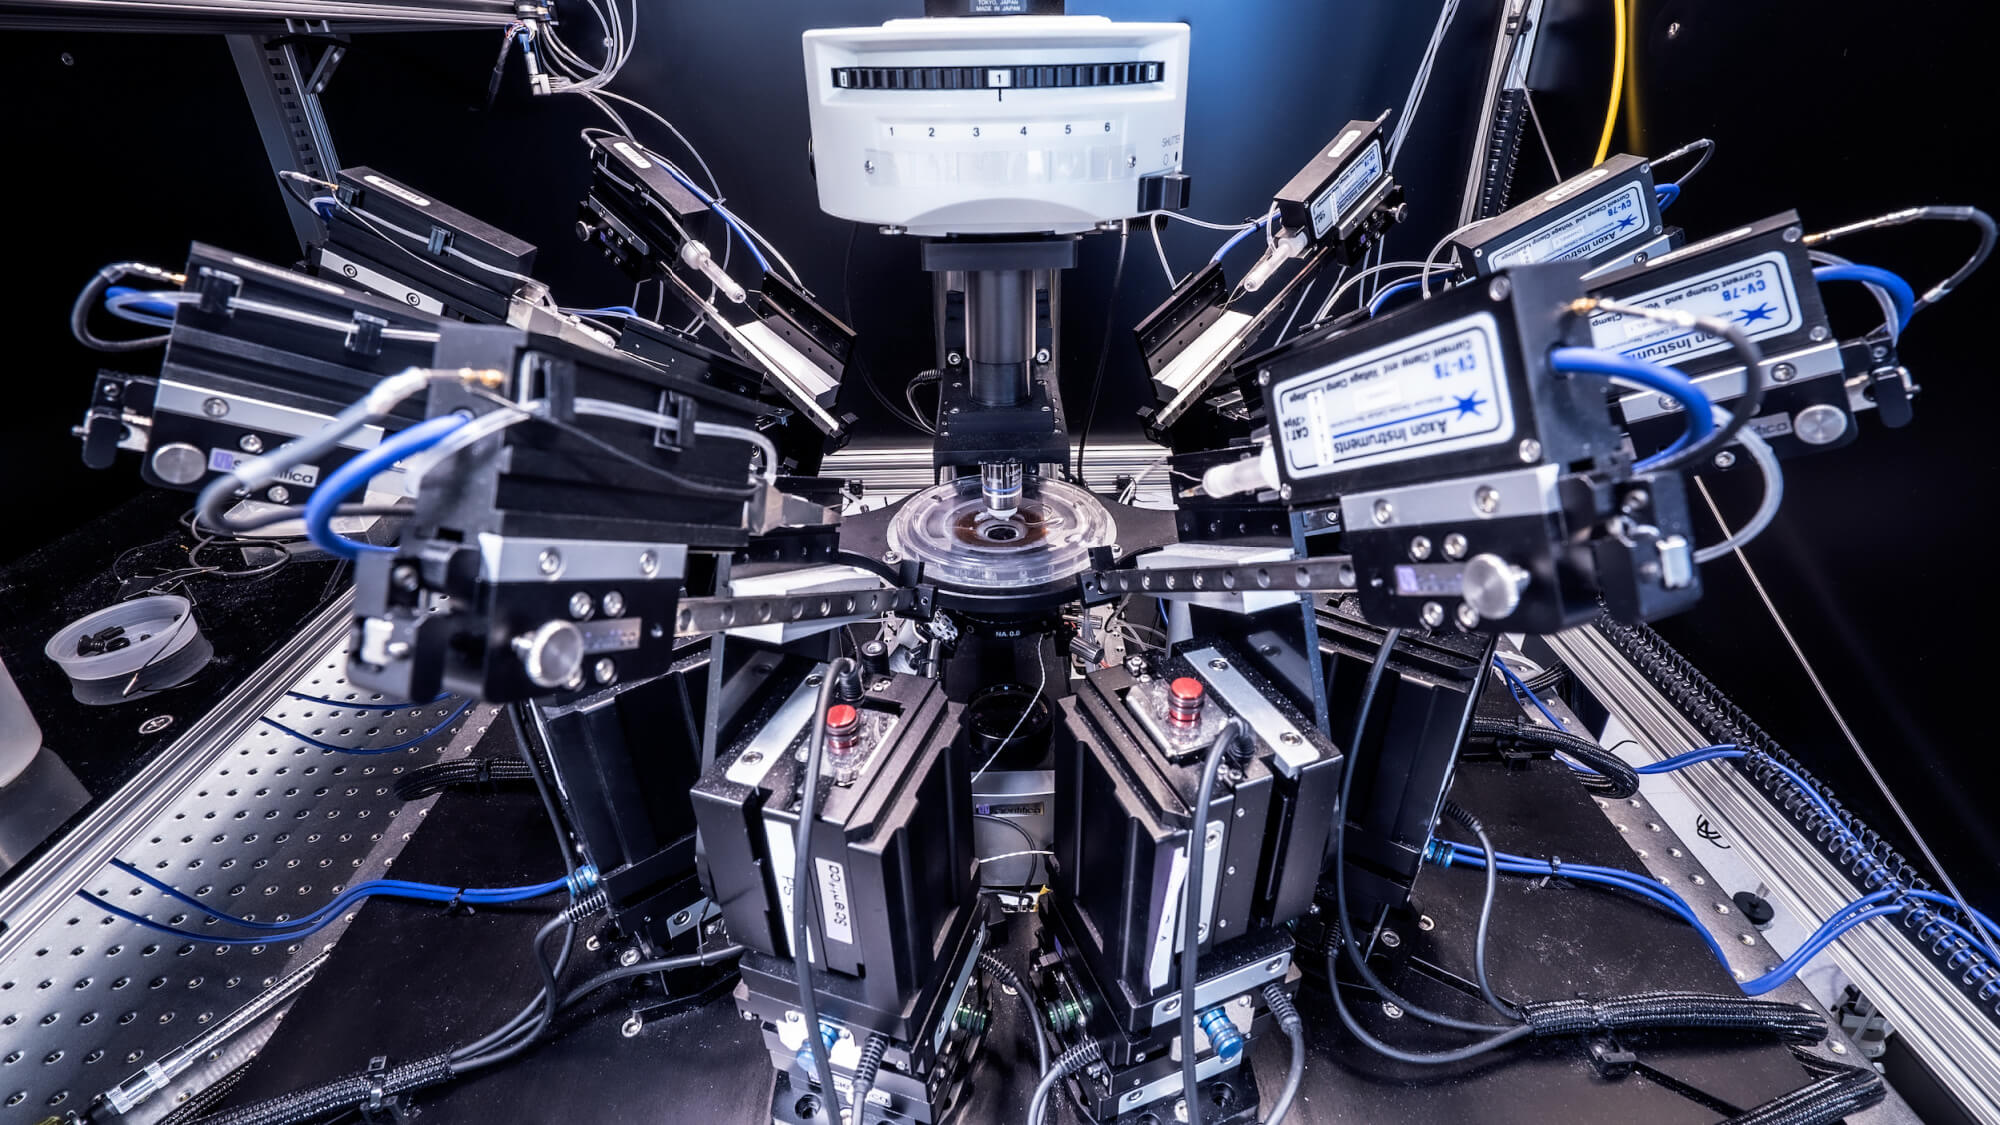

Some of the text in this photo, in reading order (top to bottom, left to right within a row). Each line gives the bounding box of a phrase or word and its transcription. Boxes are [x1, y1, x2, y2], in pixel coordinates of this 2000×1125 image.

[889, 122, 1111, 137] 1 2 3 4 5 6
[1606, 192, 1630, 207] Current
[1587, 204, 1606, 217] Clamp
[1606, 199, 1632, 216] CV-7B
[1575, 214, 1587, 224] and
[1551, 221, 1573, 236] Voltage
[1532, 232, 1550, 245] Clamp
[1591, 231, 1614, 247] Axon
[1721, 269, 1762, 288] Current
[1685, 282, 1719, 298] Clamp
[1721, 279, 1766, 301] CV-7B
[1664, 293, 1684, 305] and
[1591, 312, 1622, 327] Clamp
[1432, 338, 1471, 358] Current
[1384, 361, 1398, 373] and
[1401, 352, 1430, 368] Clamp
[1433, 354, 1475, 379] CV-7B
[1349, 369, 1378, 384] Voltage
[1325, 378, 1348, 393] Clamp
[1290, 426, 1309, 440] CAT
[1333, 419, 1446, 454] Axon Instruments
